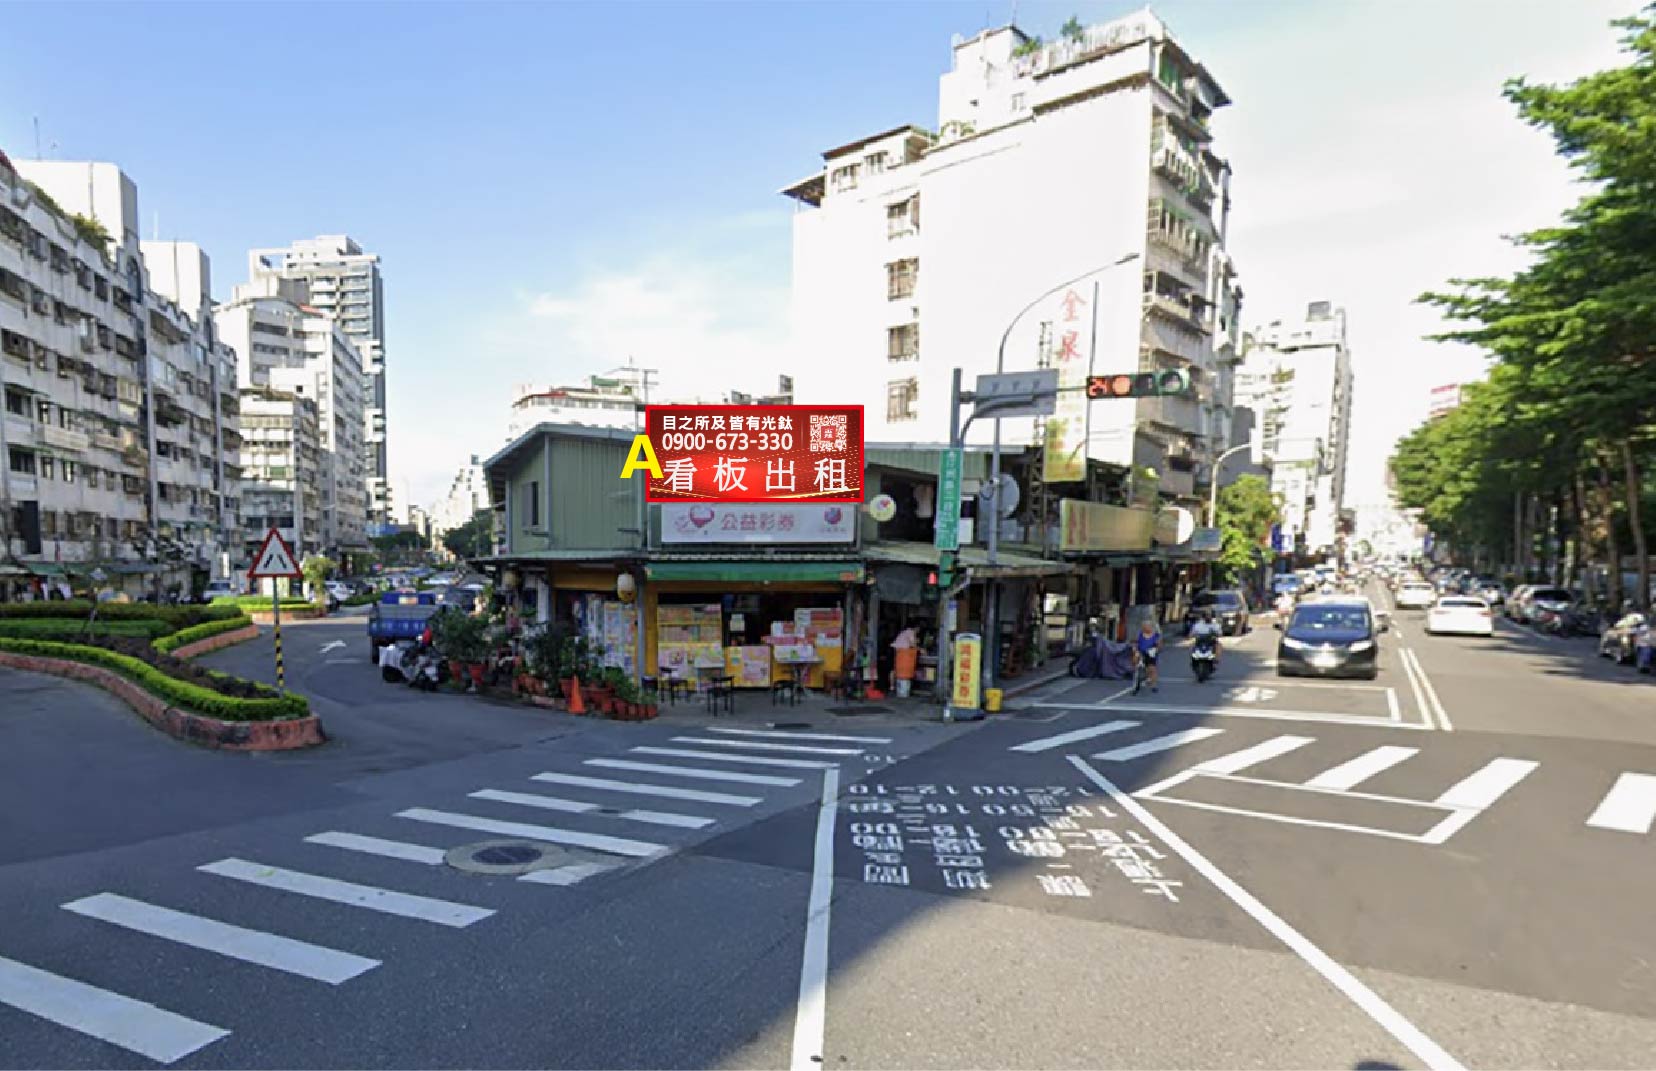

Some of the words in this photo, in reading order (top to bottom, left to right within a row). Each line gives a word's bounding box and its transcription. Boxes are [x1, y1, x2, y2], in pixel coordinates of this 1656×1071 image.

[662, 432, 793, 451] 0900-673-330
[663, 456, 850, 492] 看板出租
